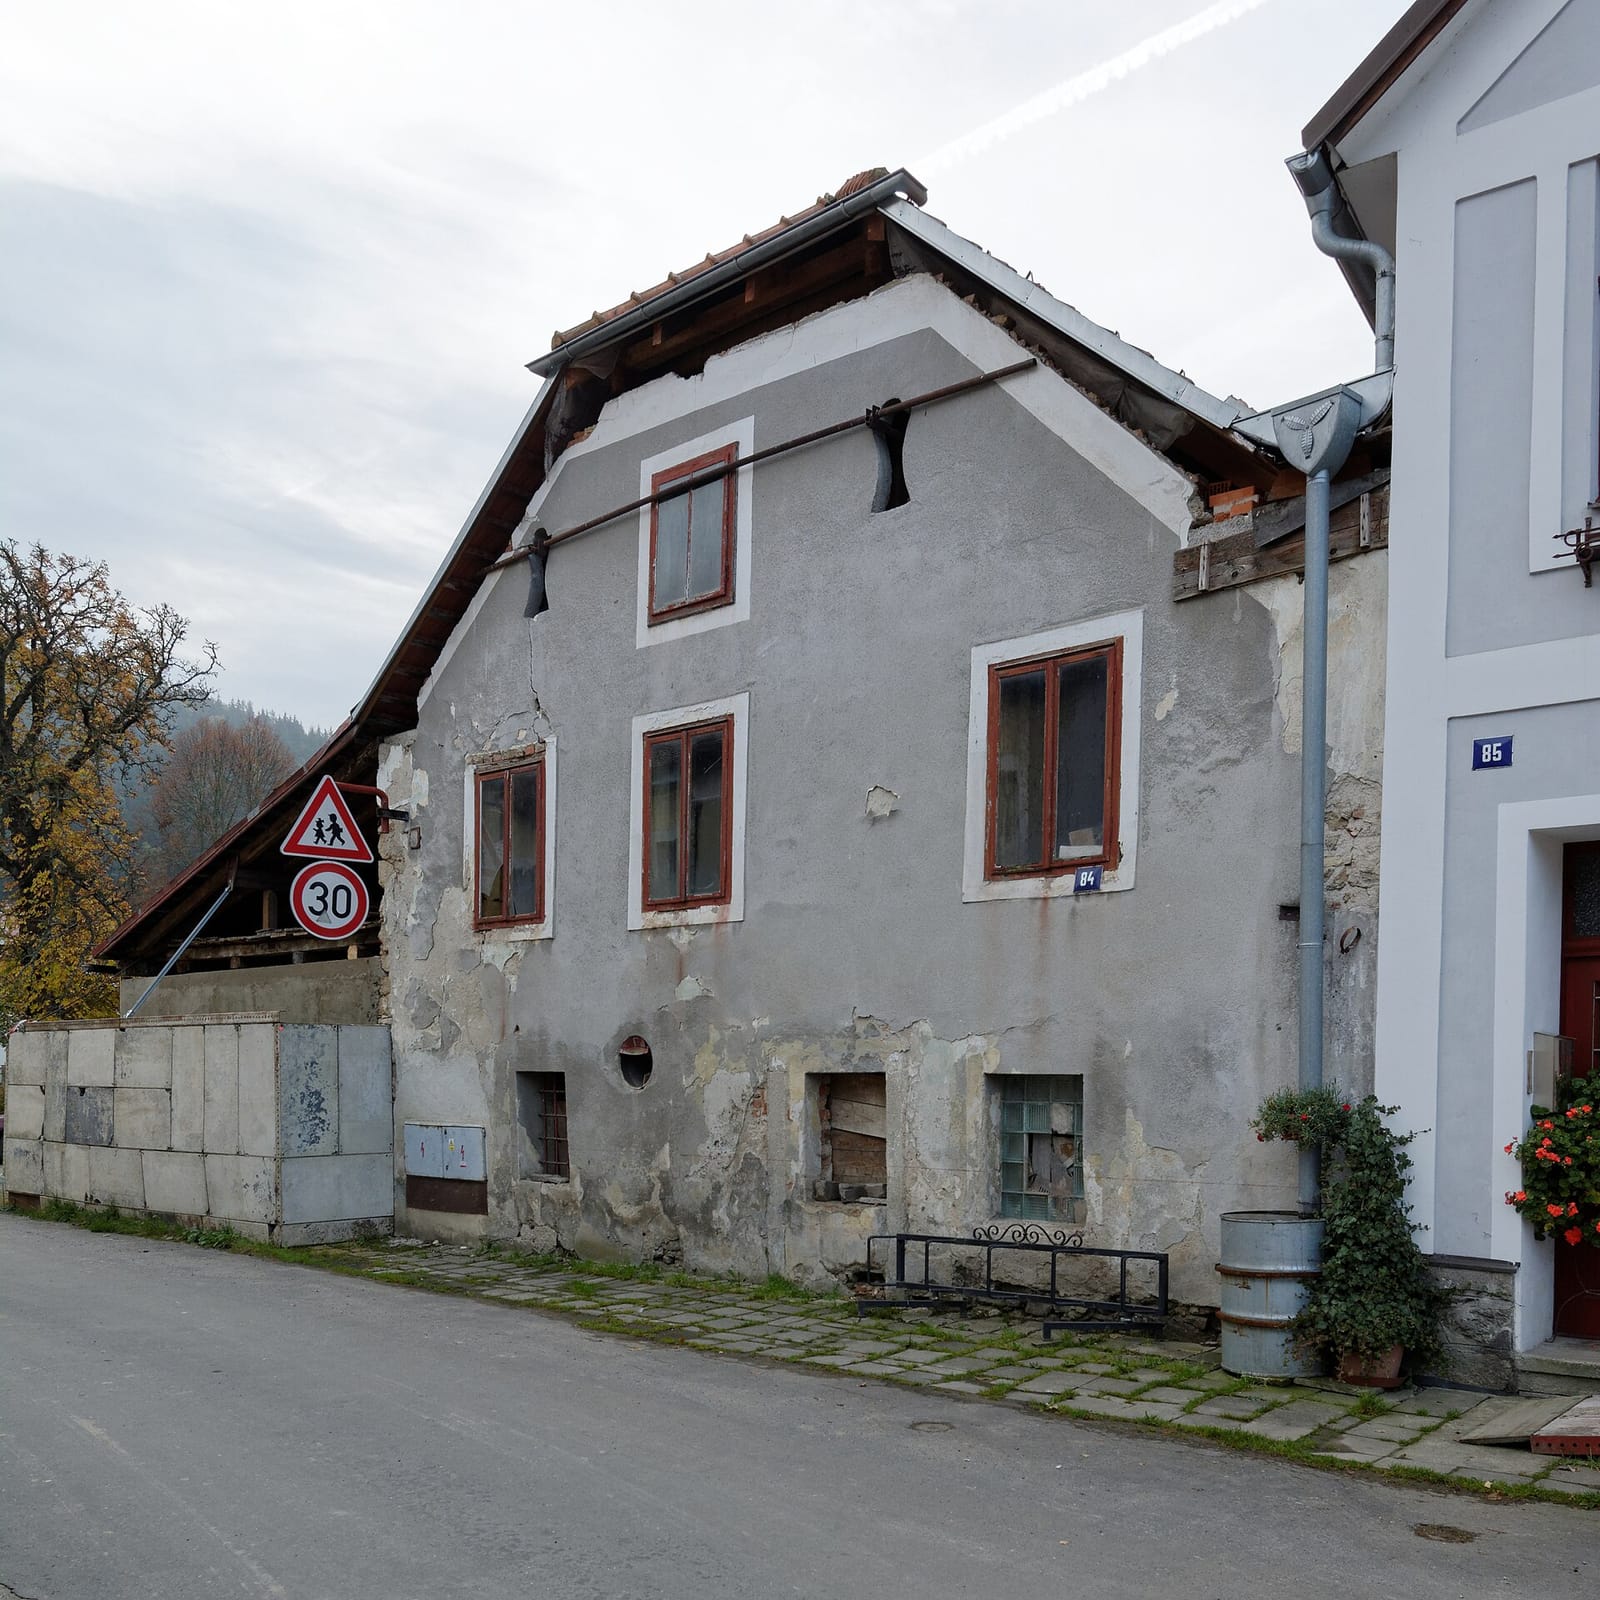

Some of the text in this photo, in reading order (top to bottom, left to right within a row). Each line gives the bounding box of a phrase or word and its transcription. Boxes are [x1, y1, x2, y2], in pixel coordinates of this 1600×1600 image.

[1482, 743, 1502, 763] 85
[1080, 871, 1095, 887] 84
[308, 881, 351, 919] 30
